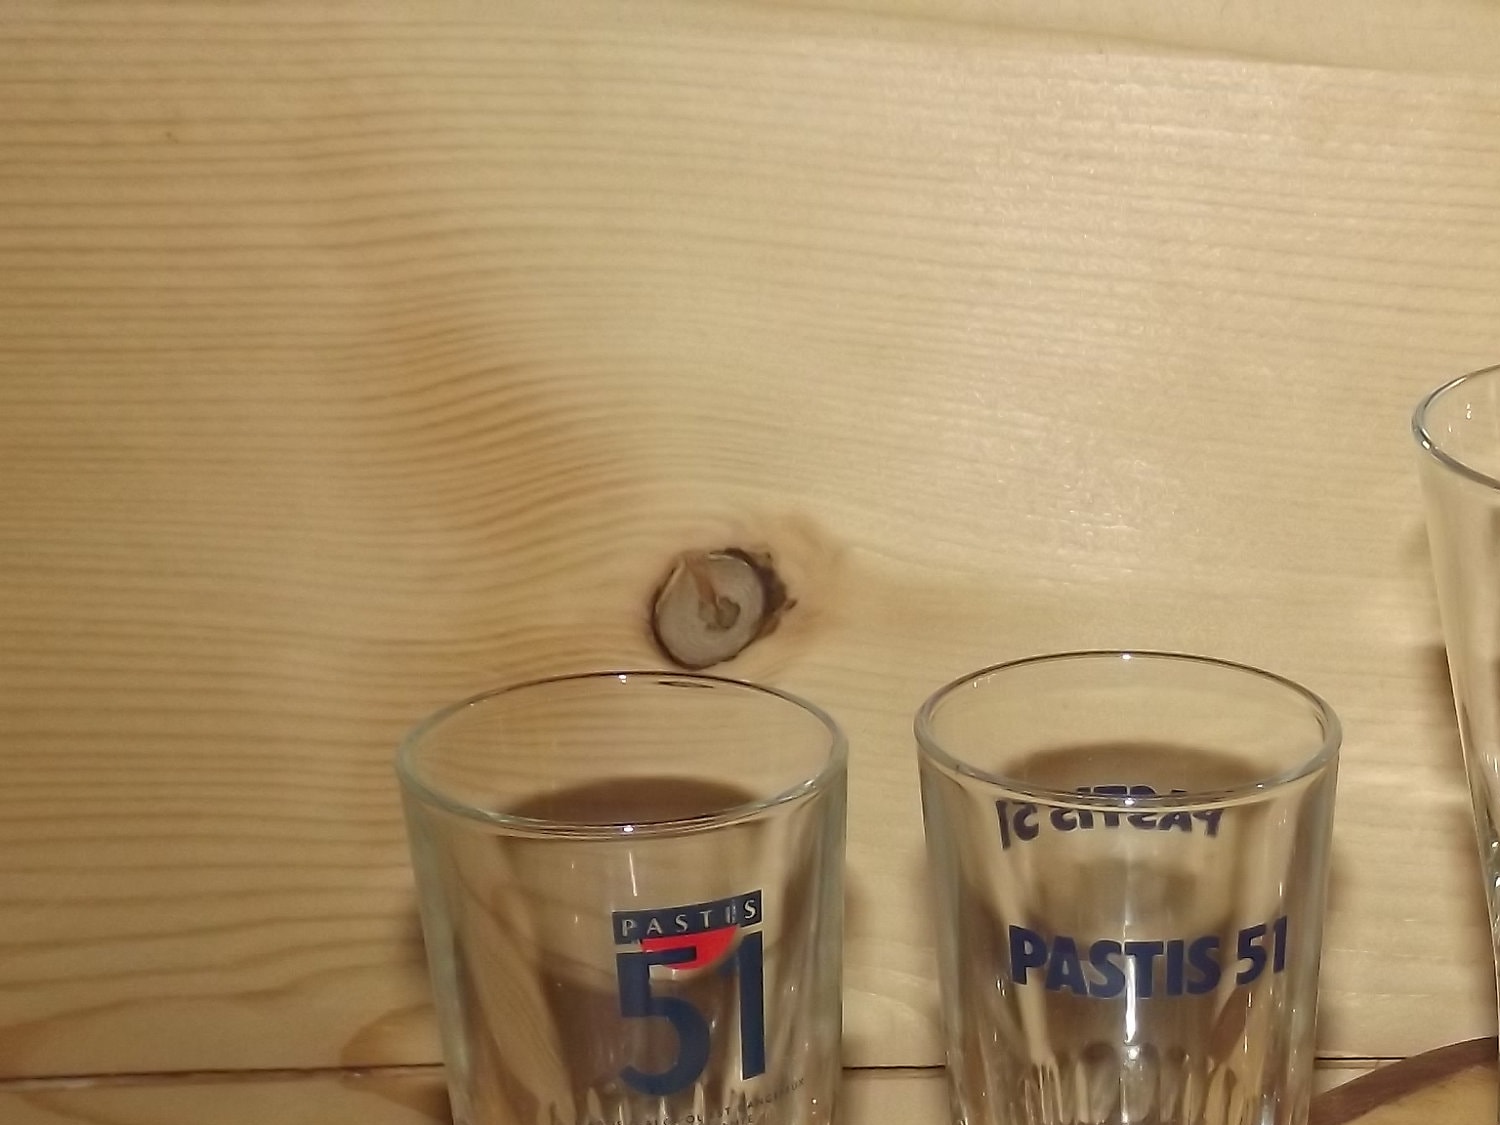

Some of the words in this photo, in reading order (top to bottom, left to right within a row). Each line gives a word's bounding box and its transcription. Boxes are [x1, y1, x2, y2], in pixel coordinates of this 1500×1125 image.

[618, 896, 760, 938] PASTIS
[1008, 924, 1222, 999] PASTIS
[1236, 915, 1288, 986] 51
[615, 930, 766, 1096] 51
